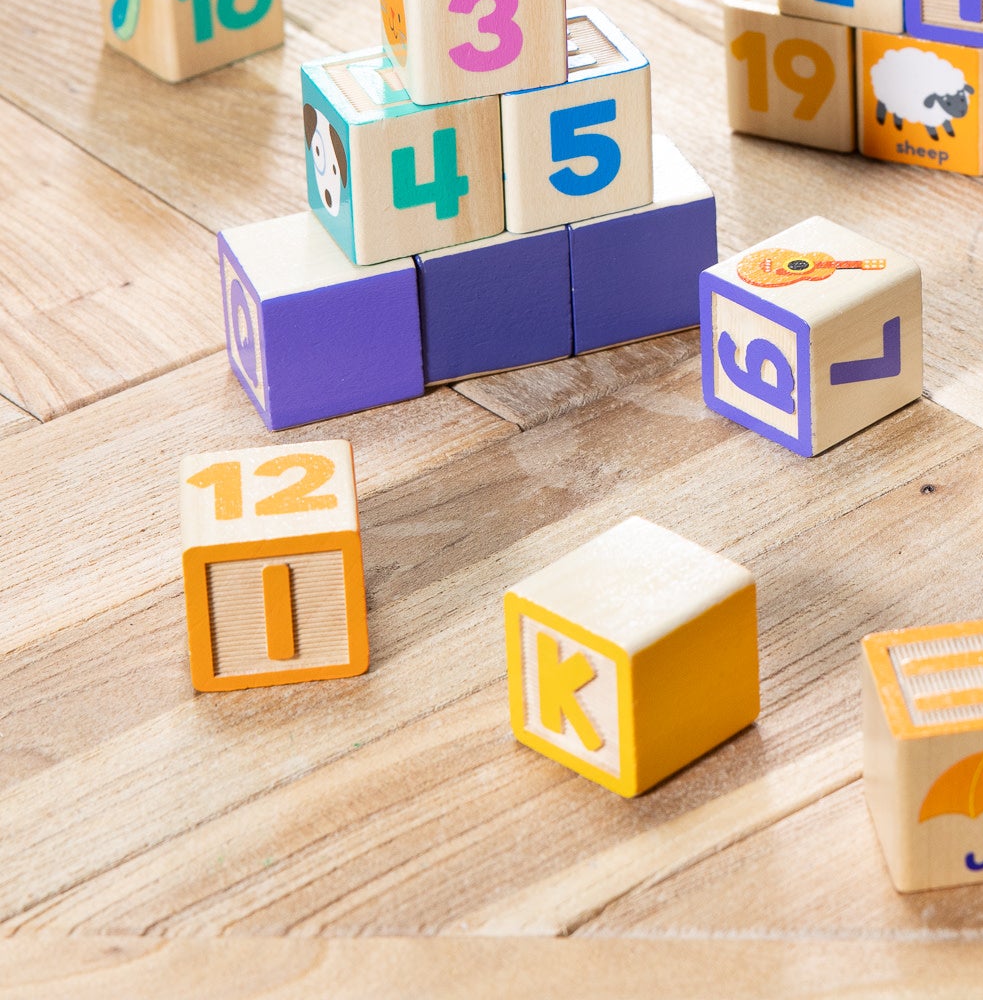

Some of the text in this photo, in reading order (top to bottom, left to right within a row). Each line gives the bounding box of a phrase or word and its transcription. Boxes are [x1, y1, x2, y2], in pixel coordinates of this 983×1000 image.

[730, 30, 836, 121] 19
[391, 127, 469, 220] 4
[549, 99, 621, 196] 5
[896, 139, 949, 165] sheep
[718, 331, 796, 414] G
[186, 453, 338, 520] 12
[536, 631, 604, 752] K
